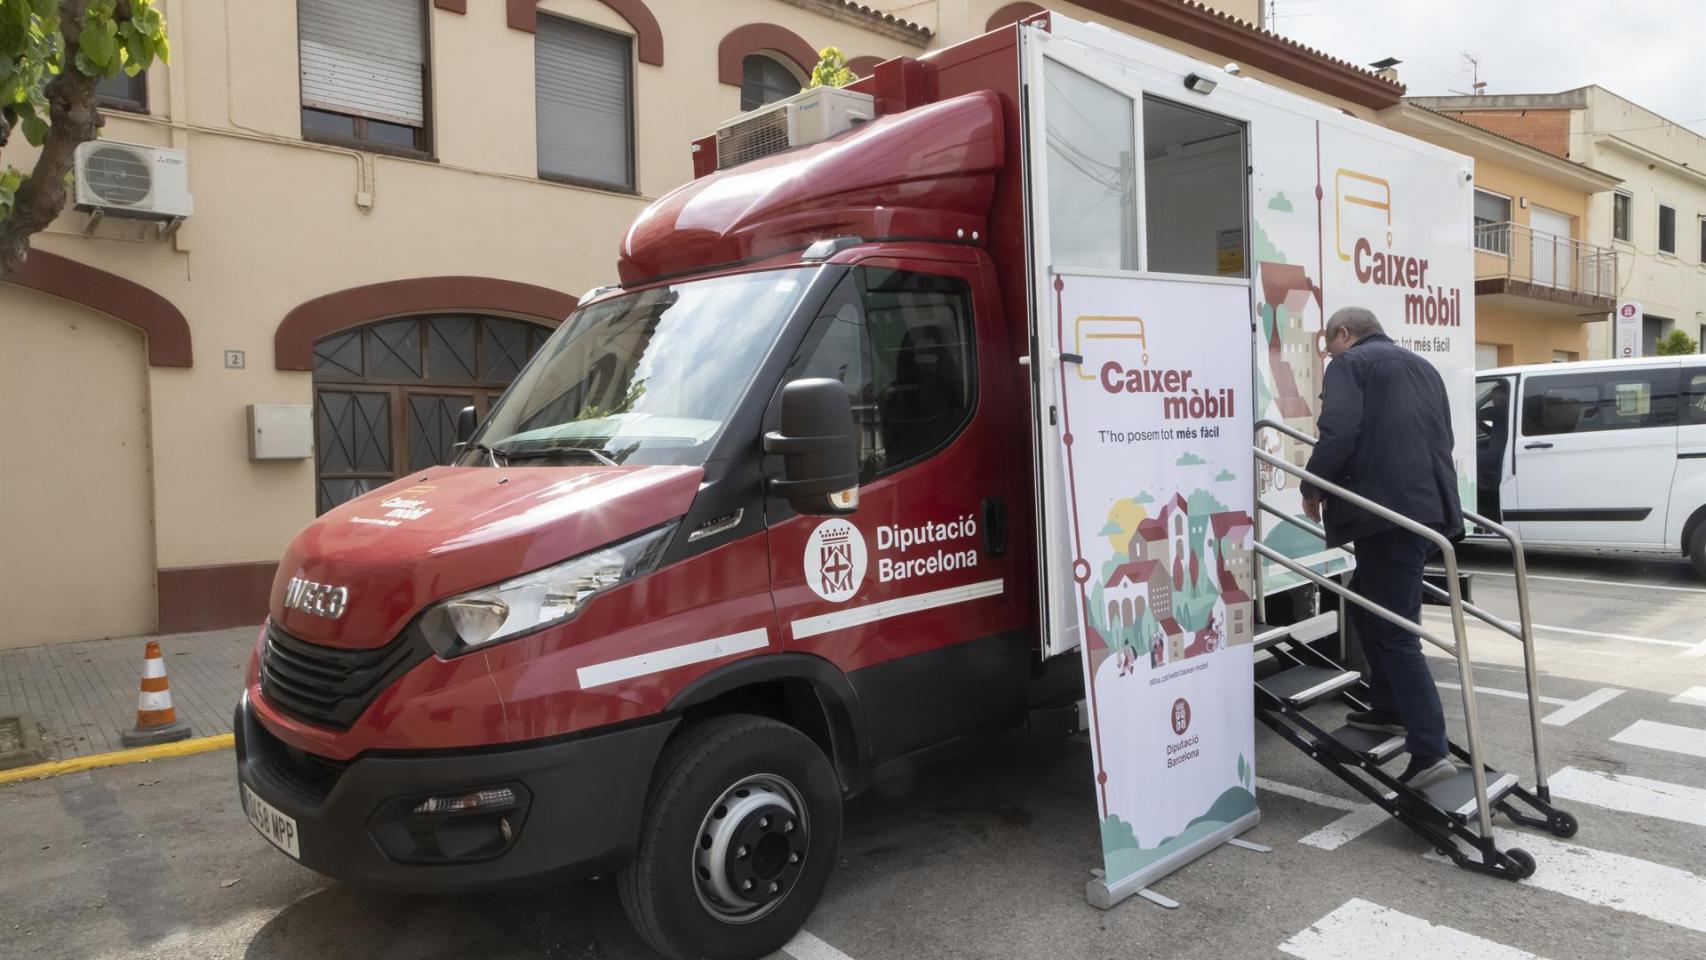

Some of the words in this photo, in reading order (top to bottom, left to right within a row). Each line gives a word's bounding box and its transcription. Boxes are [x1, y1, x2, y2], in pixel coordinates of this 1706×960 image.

[1354, 237, 1428, 289] Caixer
[1405, 285, 1461, 327] mòbil
[231, 354, 239, 365] 2
[1414, 336, 1431, 352] més
[1433, 336, 1450, 352] fàcil
[1100, 361, 1192, 394] Caixer
[1164, 389, 1234, 419] mòbil
[1099, 429, 1125, 443] T'ho
[1127, 430, 1160, 444] posem
[1161, 428, 1174, 441] tot
[1176, 427, 1198, 439] més
[1200, 426, 1220, 439] fàcil
[876, 513, 977, 552] Diputació
[879, 549, 978, 583] Barcelona
[284, 577, 348, 620] IVECO
[1166, 734, 1199, 755] Diputació
[1167, 749, 1200, 768] Barcelona
